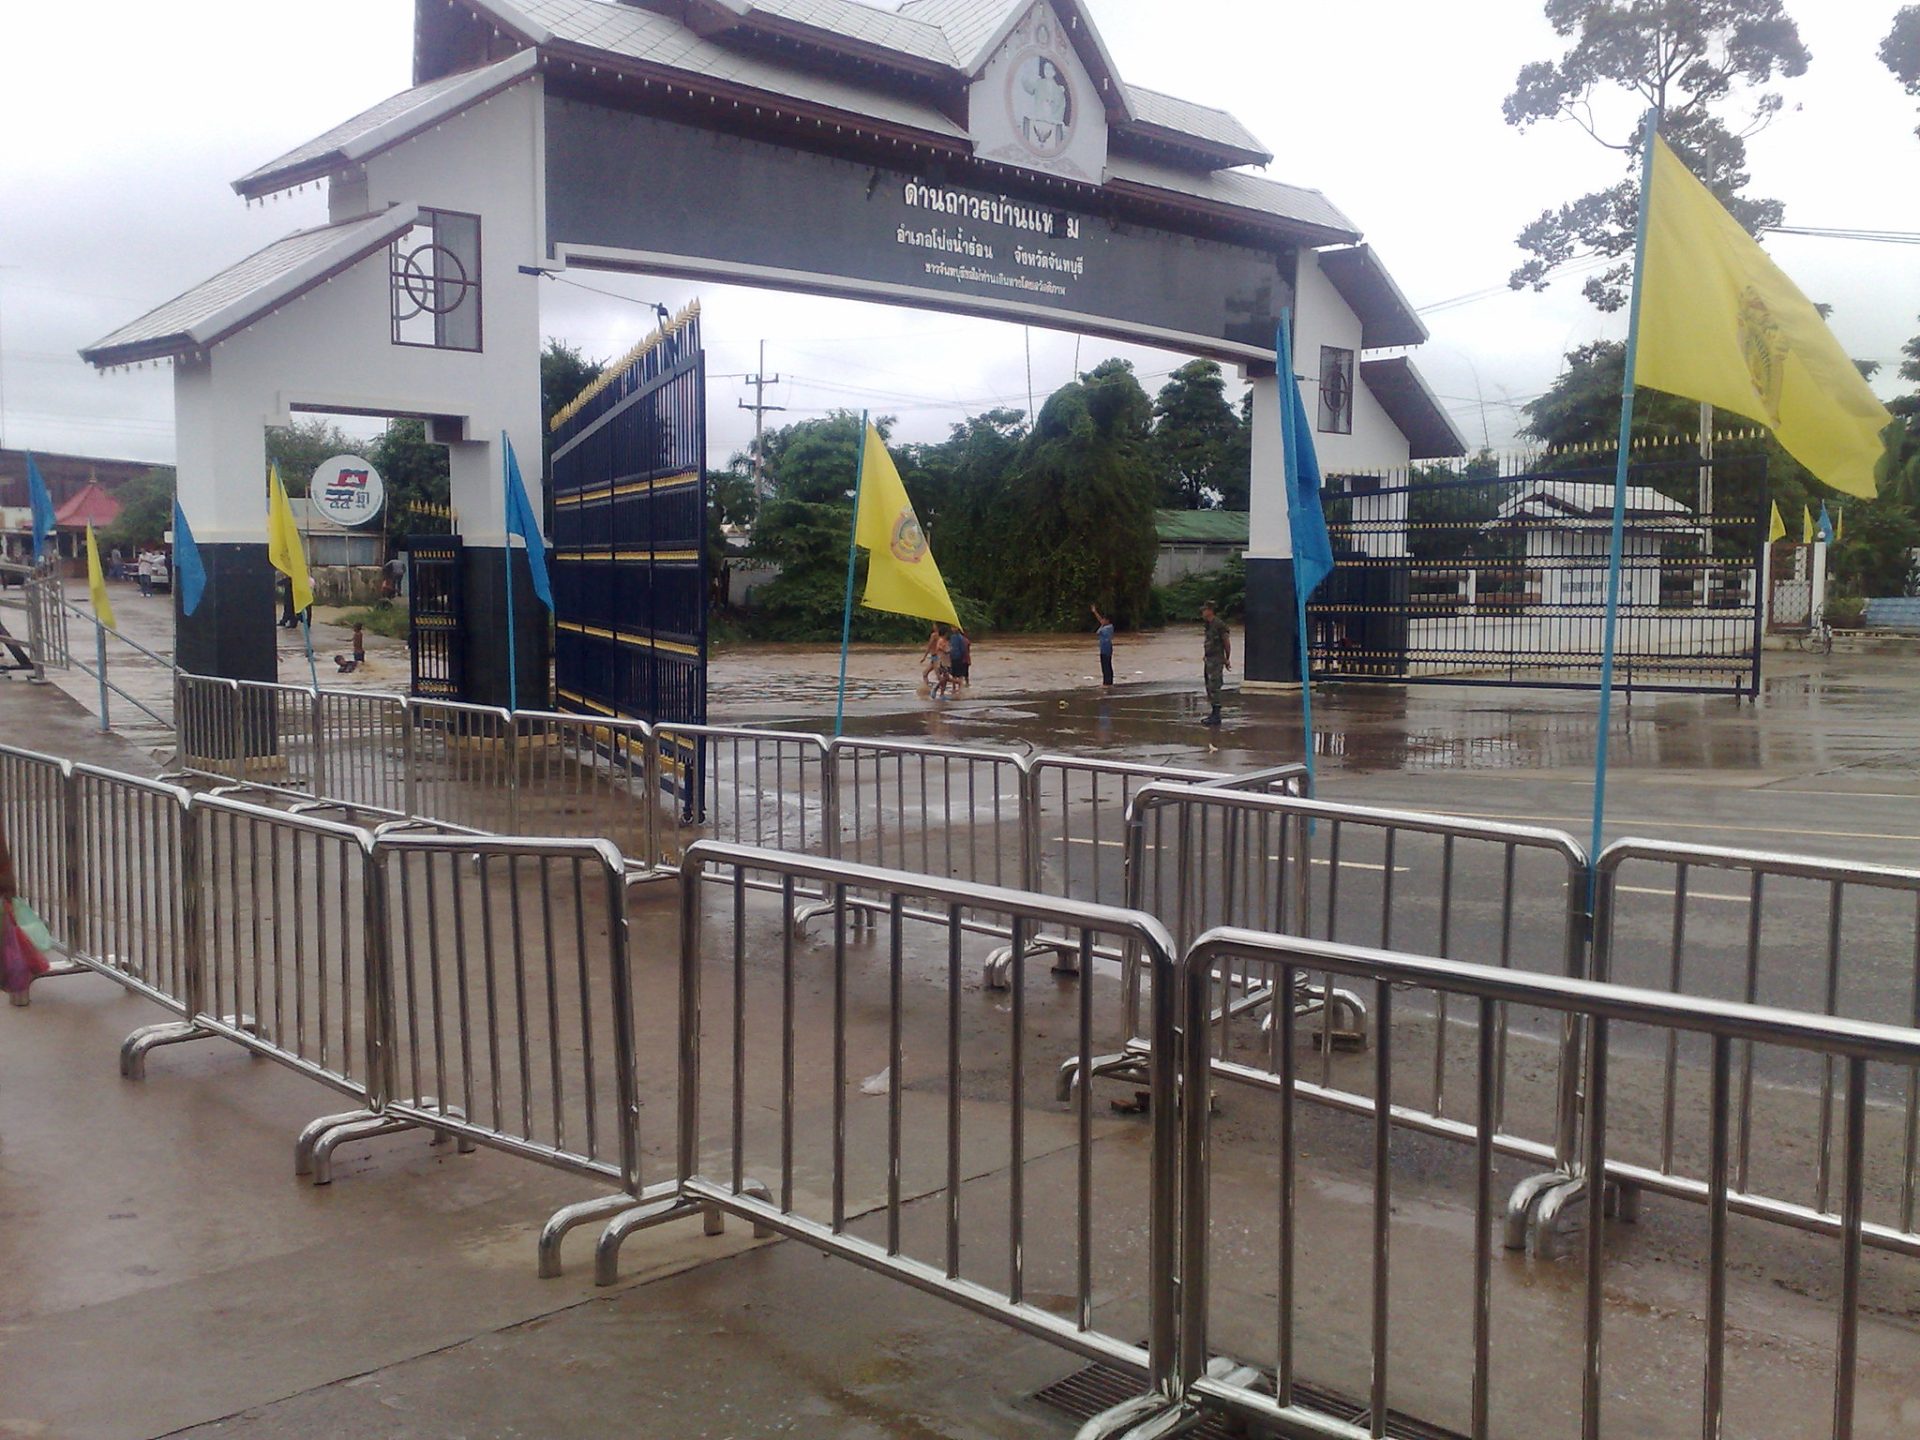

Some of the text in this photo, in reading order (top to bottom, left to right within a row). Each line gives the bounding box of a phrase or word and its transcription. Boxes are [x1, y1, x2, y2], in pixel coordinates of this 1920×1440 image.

[896, 223, 1085, 281] อำเภอโป่งน้ำร้อน จังหวัดจันทบุรี
